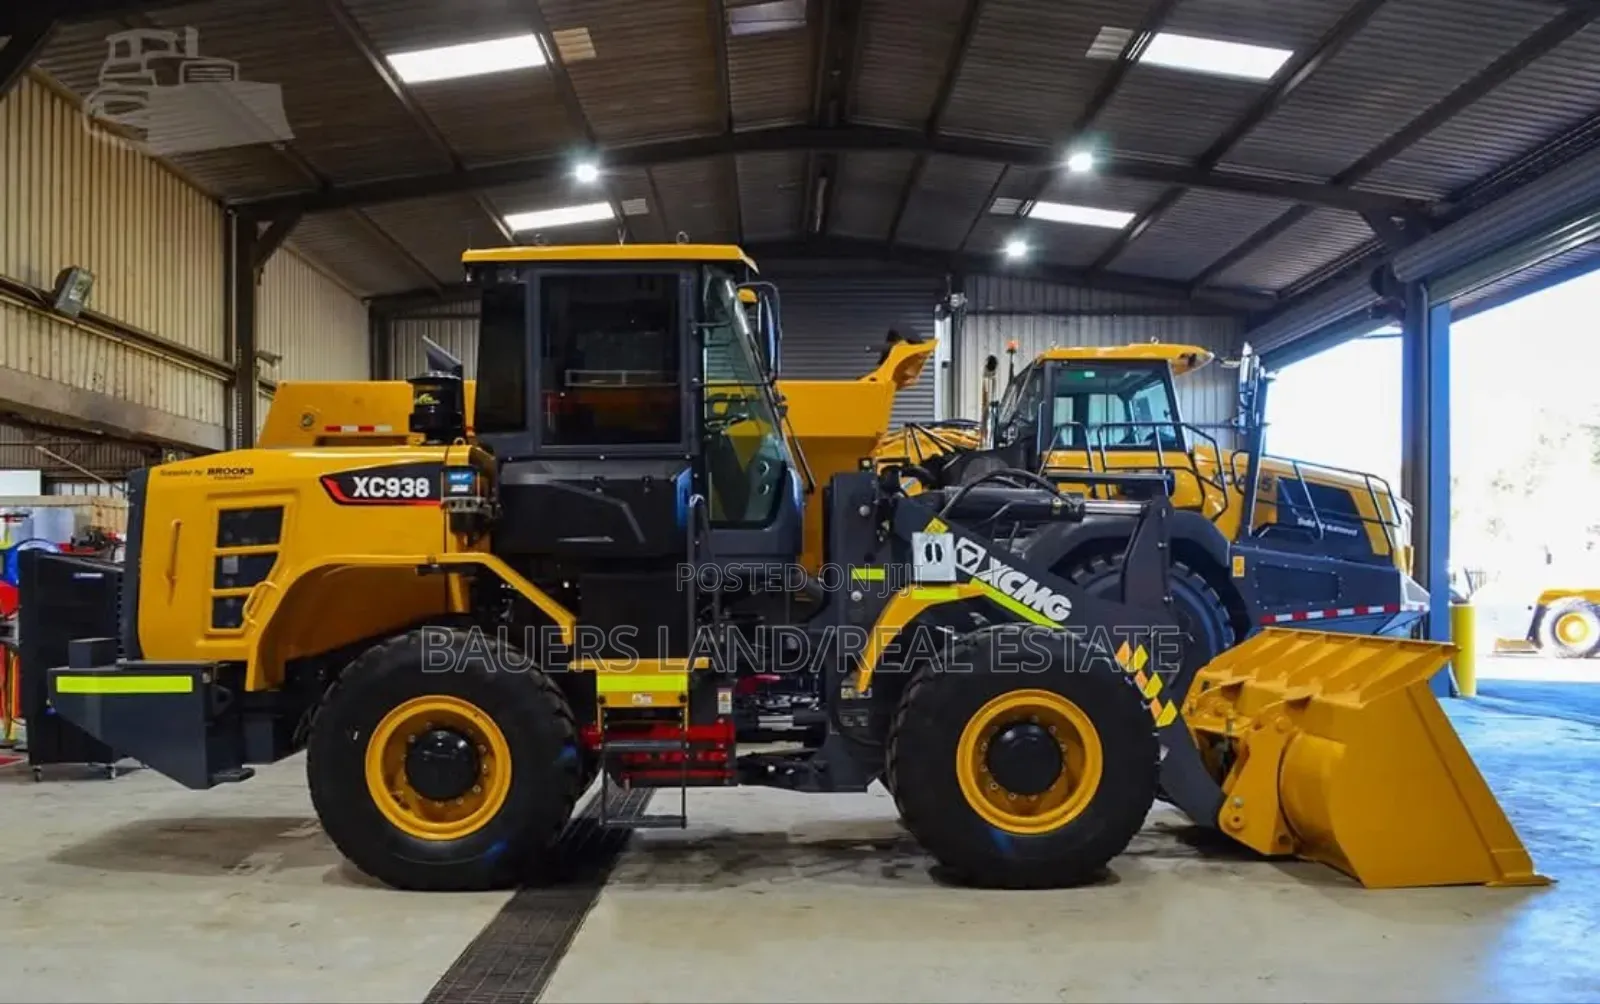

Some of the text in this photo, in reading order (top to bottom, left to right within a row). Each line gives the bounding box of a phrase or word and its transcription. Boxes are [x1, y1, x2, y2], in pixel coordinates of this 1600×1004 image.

[207, 467, 254, 476] BROOKS
[352, 476, 430, 498] XC938
[974, 556, 1072, 621] XCMG
